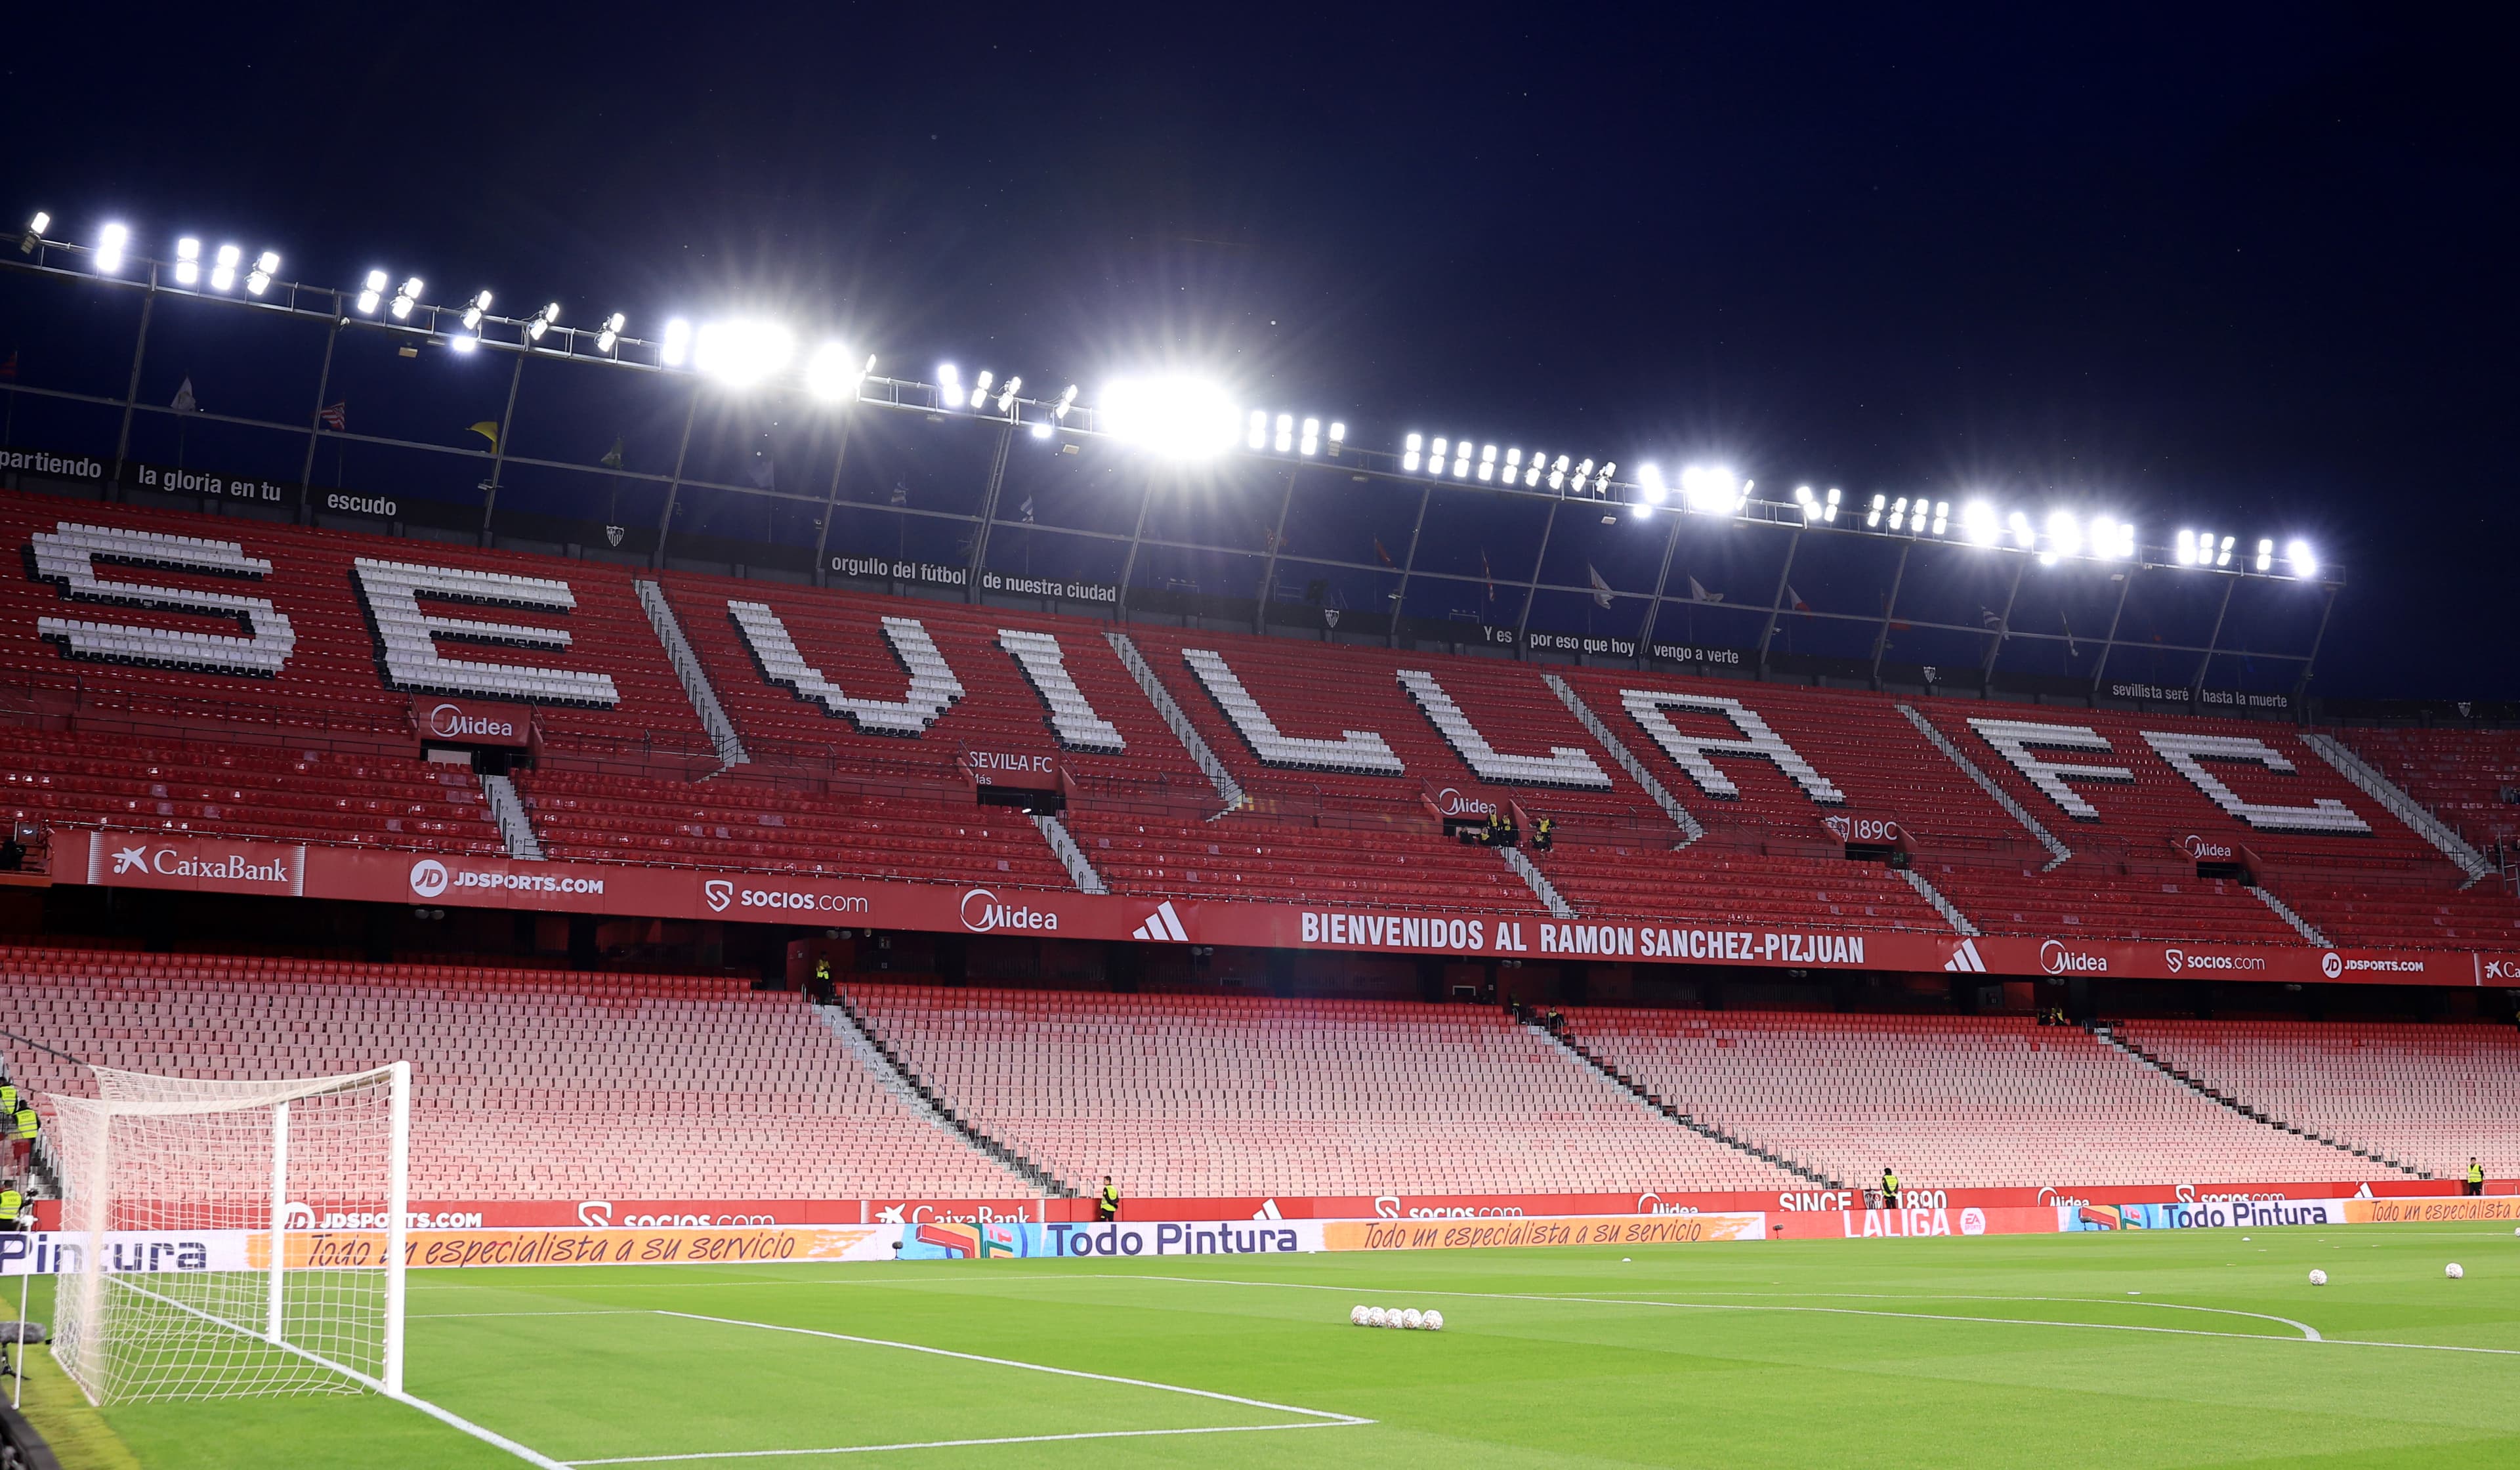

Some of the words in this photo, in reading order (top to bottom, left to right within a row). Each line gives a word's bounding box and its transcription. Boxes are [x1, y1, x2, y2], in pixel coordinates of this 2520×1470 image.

[0, 451, 102, 478] partiendo
[138, 465, 156, 485] la
[164, 470, 222, 494] gloria
[230, 480, 255, 497] en
[261, 482, 281, 501] tu
[327, 494, 397, 516] escudo
[831, 556, 888, 576] orgullo
[892, 561, 915, 579] del
[921, 564, 967, 585] fútbol
[983, 572, 1001, 589] de
[1006, 578, 1062, 596] nuestra
[1067, 582, 1116, 602] ciudad
[1484, 626, 1493, 641] Y
[1497, 629, 1513, 643] es
[1530, 631, 1552, 648] por
[1556, 635, 1578, 649] eso
[1584, 638, 1608, 654] que
[1612, 638, 1635, 657] hoy
[1654, 644, 1692, 662] vengo
[1695, 648, 1703, 660] a
[1707, 650, 1738, 664] verte
[2112, 683, 2162, 699] sevillista
[2166, 687, 2189, 701] seré
[2202, 689, 2233, 704] hasta
[2236, 692, 2246, 705] la
[2249, 694, 2287, 707] muerte
[431, 712, 513, 738] Midea
[970, 751, 1029, 771] SEVILLA
[1033, 756, 1052, 773] FC
[2191, 841, 2231, 858] Midea
[154, 849, 288, 883] CaixaBank
[453, 872, 604, 894] JDSPORTS.COM
[960, 904, 1058, 932] Midea
[1301, 912, 1484, 950] BIENVENIDOS
[1495, 923, 1527, 952] AL
[1540, 923, 1634, 956] RAMON
[1640, 927, 1864, 964] SANCHEZ-PIZJUAN
[2041, 952, 2107, 975] Midea
[2344, 959, 2424, 972] JDSPORTS.COM
[1779, 1191, 1852, 1211] SINCE
[2371, 1200, 2399, 1221] Todo
[2404, 1206, 2421, 1221] un
[2425, 1200, 2511, 1221] especialista
[320, 1212, 482, 1228] JDSPOTS.COM
[1843, 1209, 1951, 1238] LALIGA
[1965, 1213, 1981, 1225] EA
[2162, 1204, 2225, 1229] Todo
[2233, 1201, 2328, 1228] Pintura
[1047, 1224, 1143, 1256] Todo
[1157, 1223, 1298, 1255] Pintura
[1364, 1223, 1404, 1249] Todo
[1413, 1228, 1438, 1248] un
[1444, 1221, 1569, 1249] especialista
[1576, 1225, 1588, 1244] a
[1593, 1225, 1620, 1243] su
[1627, 1220, 1702, 1242] servicio
[308, 1233, 371, 1266] Todo
[425, 1232, 608, 1267] especialista
[616, 1240, 635, 1262] a
[642, 1236, 681, 1260] su
[688, 1232, 795, 1260] servicio
